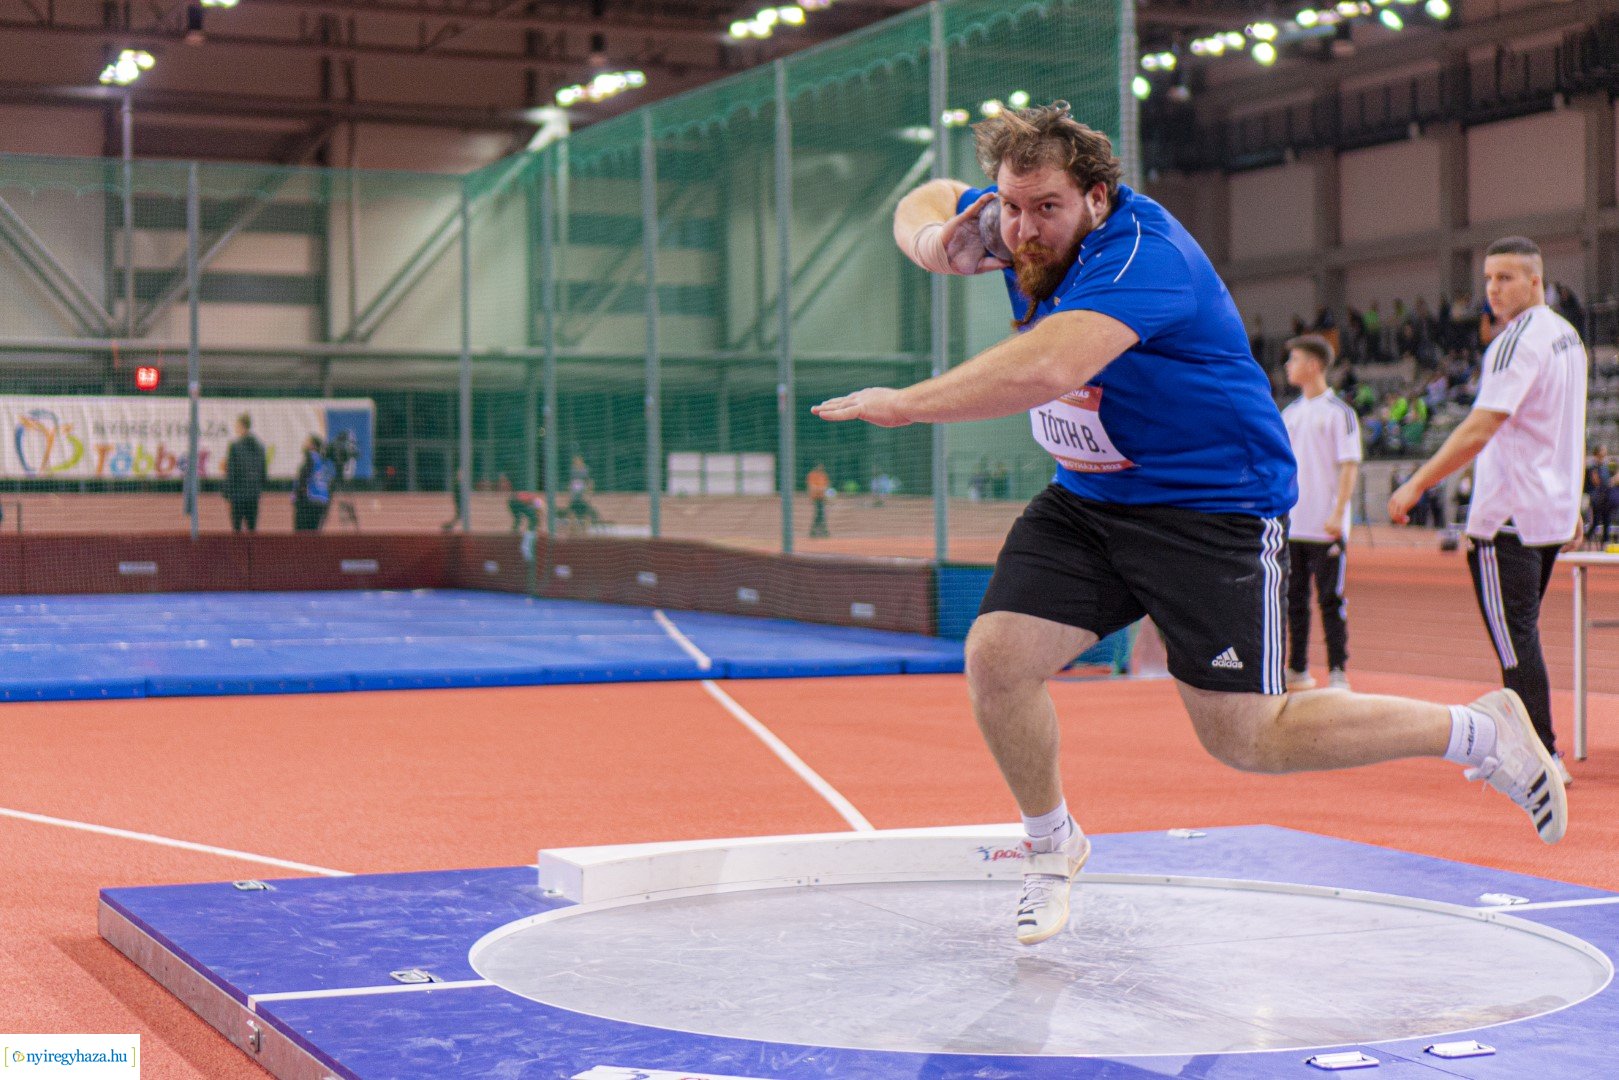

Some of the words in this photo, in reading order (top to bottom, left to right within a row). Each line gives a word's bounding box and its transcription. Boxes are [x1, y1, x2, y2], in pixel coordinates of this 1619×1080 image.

[1039, 410, 1083, 450] TÓTH
[1081, 426, 1106, 454] B.
[1211, 659, 1243, 669] adidas
